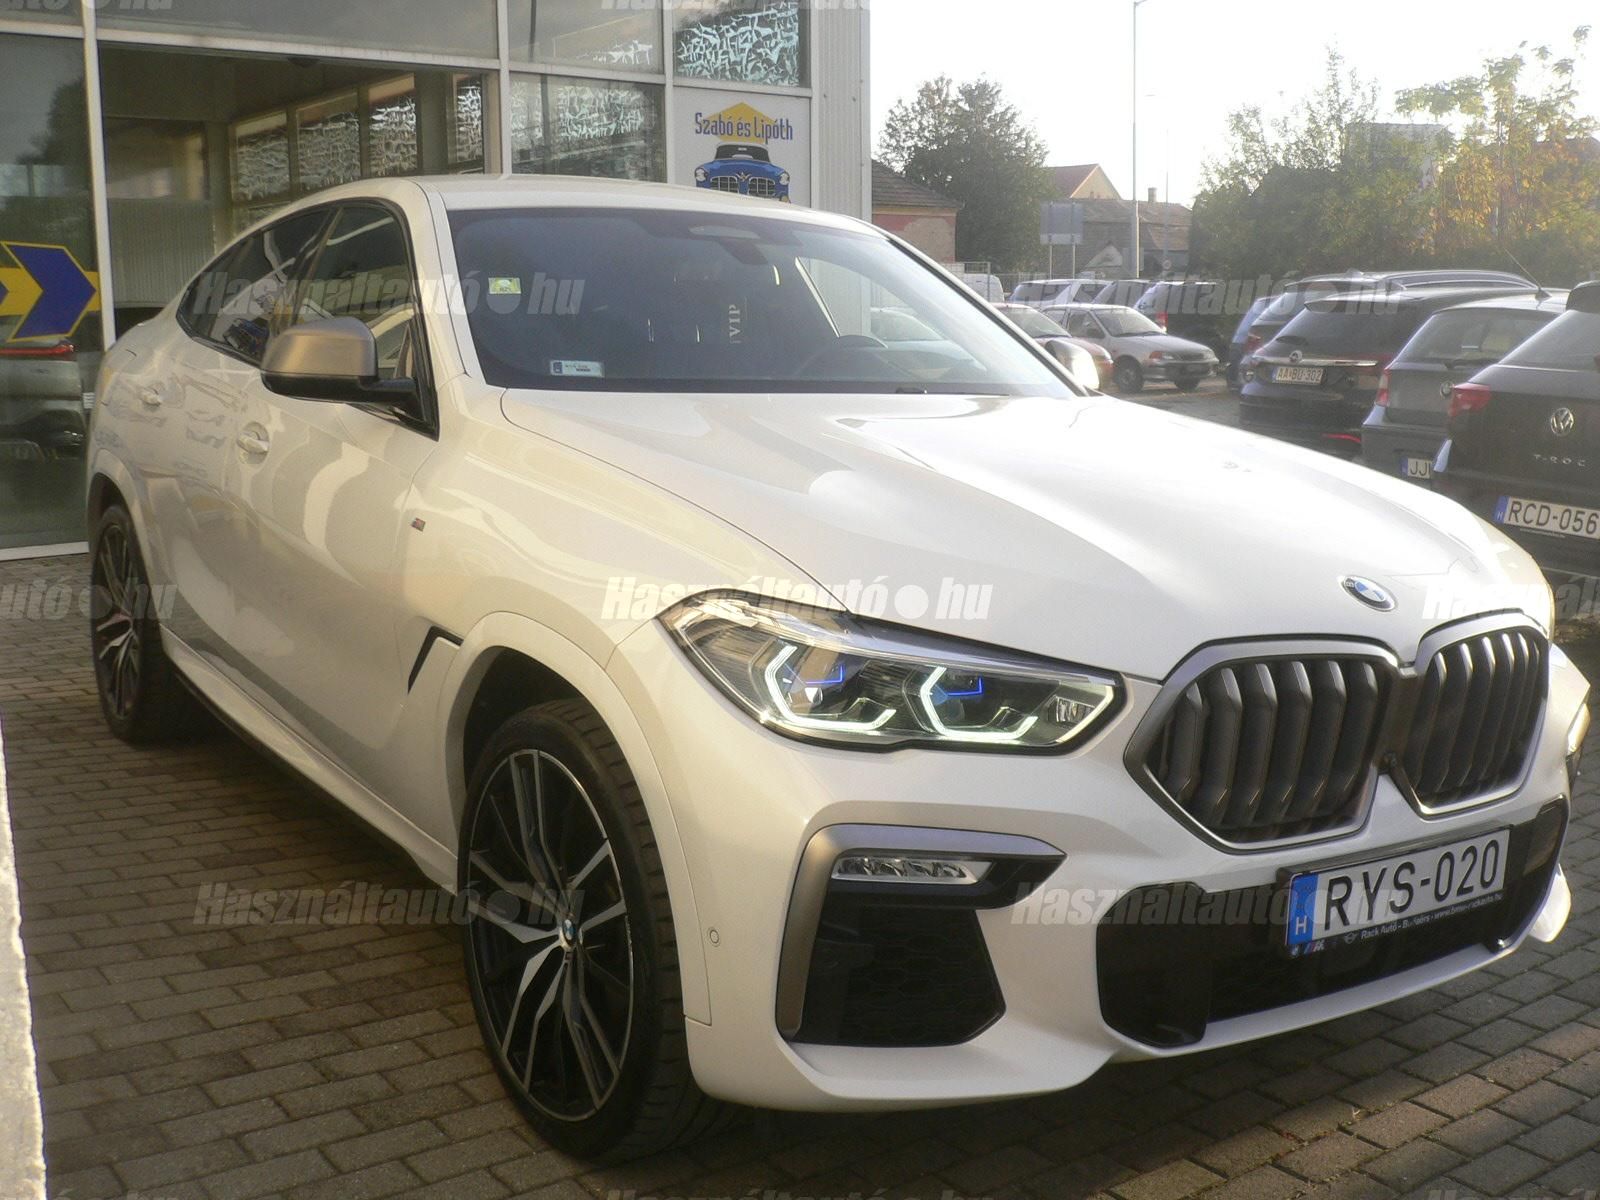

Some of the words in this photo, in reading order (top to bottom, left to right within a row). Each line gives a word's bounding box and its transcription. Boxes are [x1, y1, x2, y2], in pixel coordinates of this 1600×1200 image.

[695, 112, 733, 136] Szabó
[736, 117, 751, 137] és
[754, 116, 793, 145] Lipóth
[729, 304, 740, 338] VIP
[1410, 461, 1432, 477] JJ
[1508, 501, 1599, 535] RCD-056
[1324, 839, 1499, 931] RYS-020
